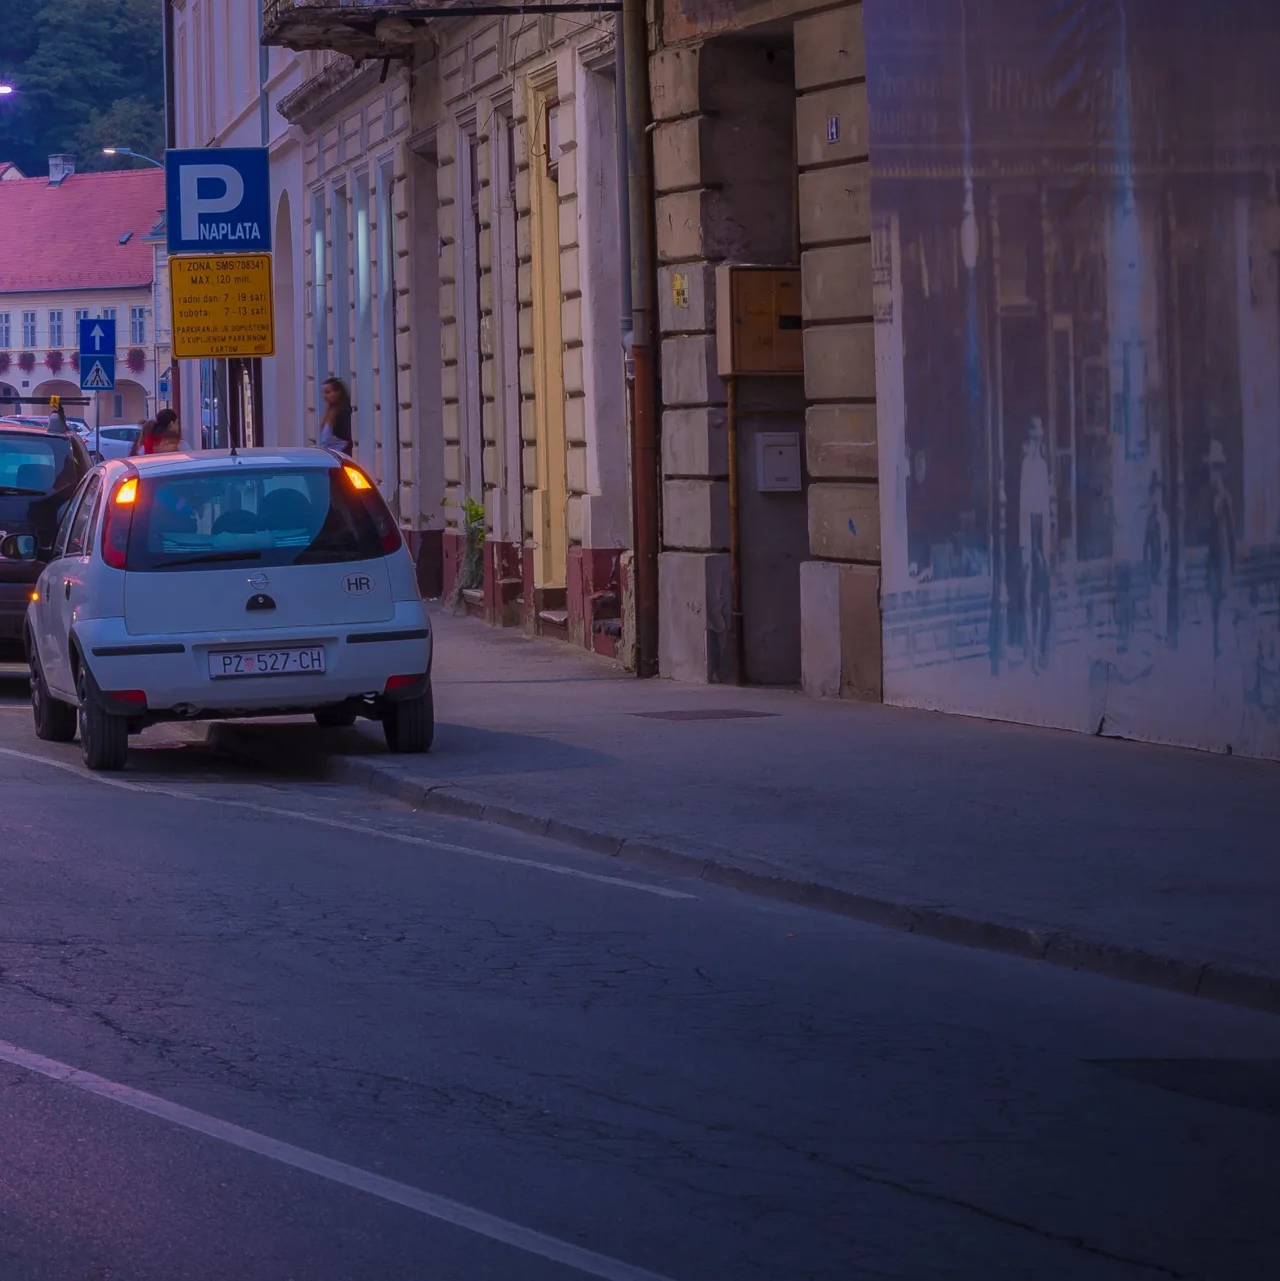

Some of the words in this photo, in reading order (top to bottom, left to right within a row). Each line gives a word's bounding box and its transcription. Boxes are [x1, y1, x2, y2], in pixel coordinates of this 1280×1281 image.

[179, 163, 244, 241] P
[200, 222, 261, 240] NAPLATA
[236, 259, 264, 270] 708341
[216, 275, 231, 284] 120
[178, 295, 200, 304] radni
[223, 293, 229, 302] 7
[237, 292, 247, 302] 19
[249, 292, 266, 302] sati
[224, 307, 230, 316] 7
[238, 306, 247, 316] 13
[250, 306, 267, 316] sati
[177, 325, 218, 334] PARKIRANJE
[187, 335, 227, 344] KUPLJENOM
[210, 345, 238, 353] KARTOM
[347, 577, 370, 591] HR
[256, 651, 322, 672] 527-CH
